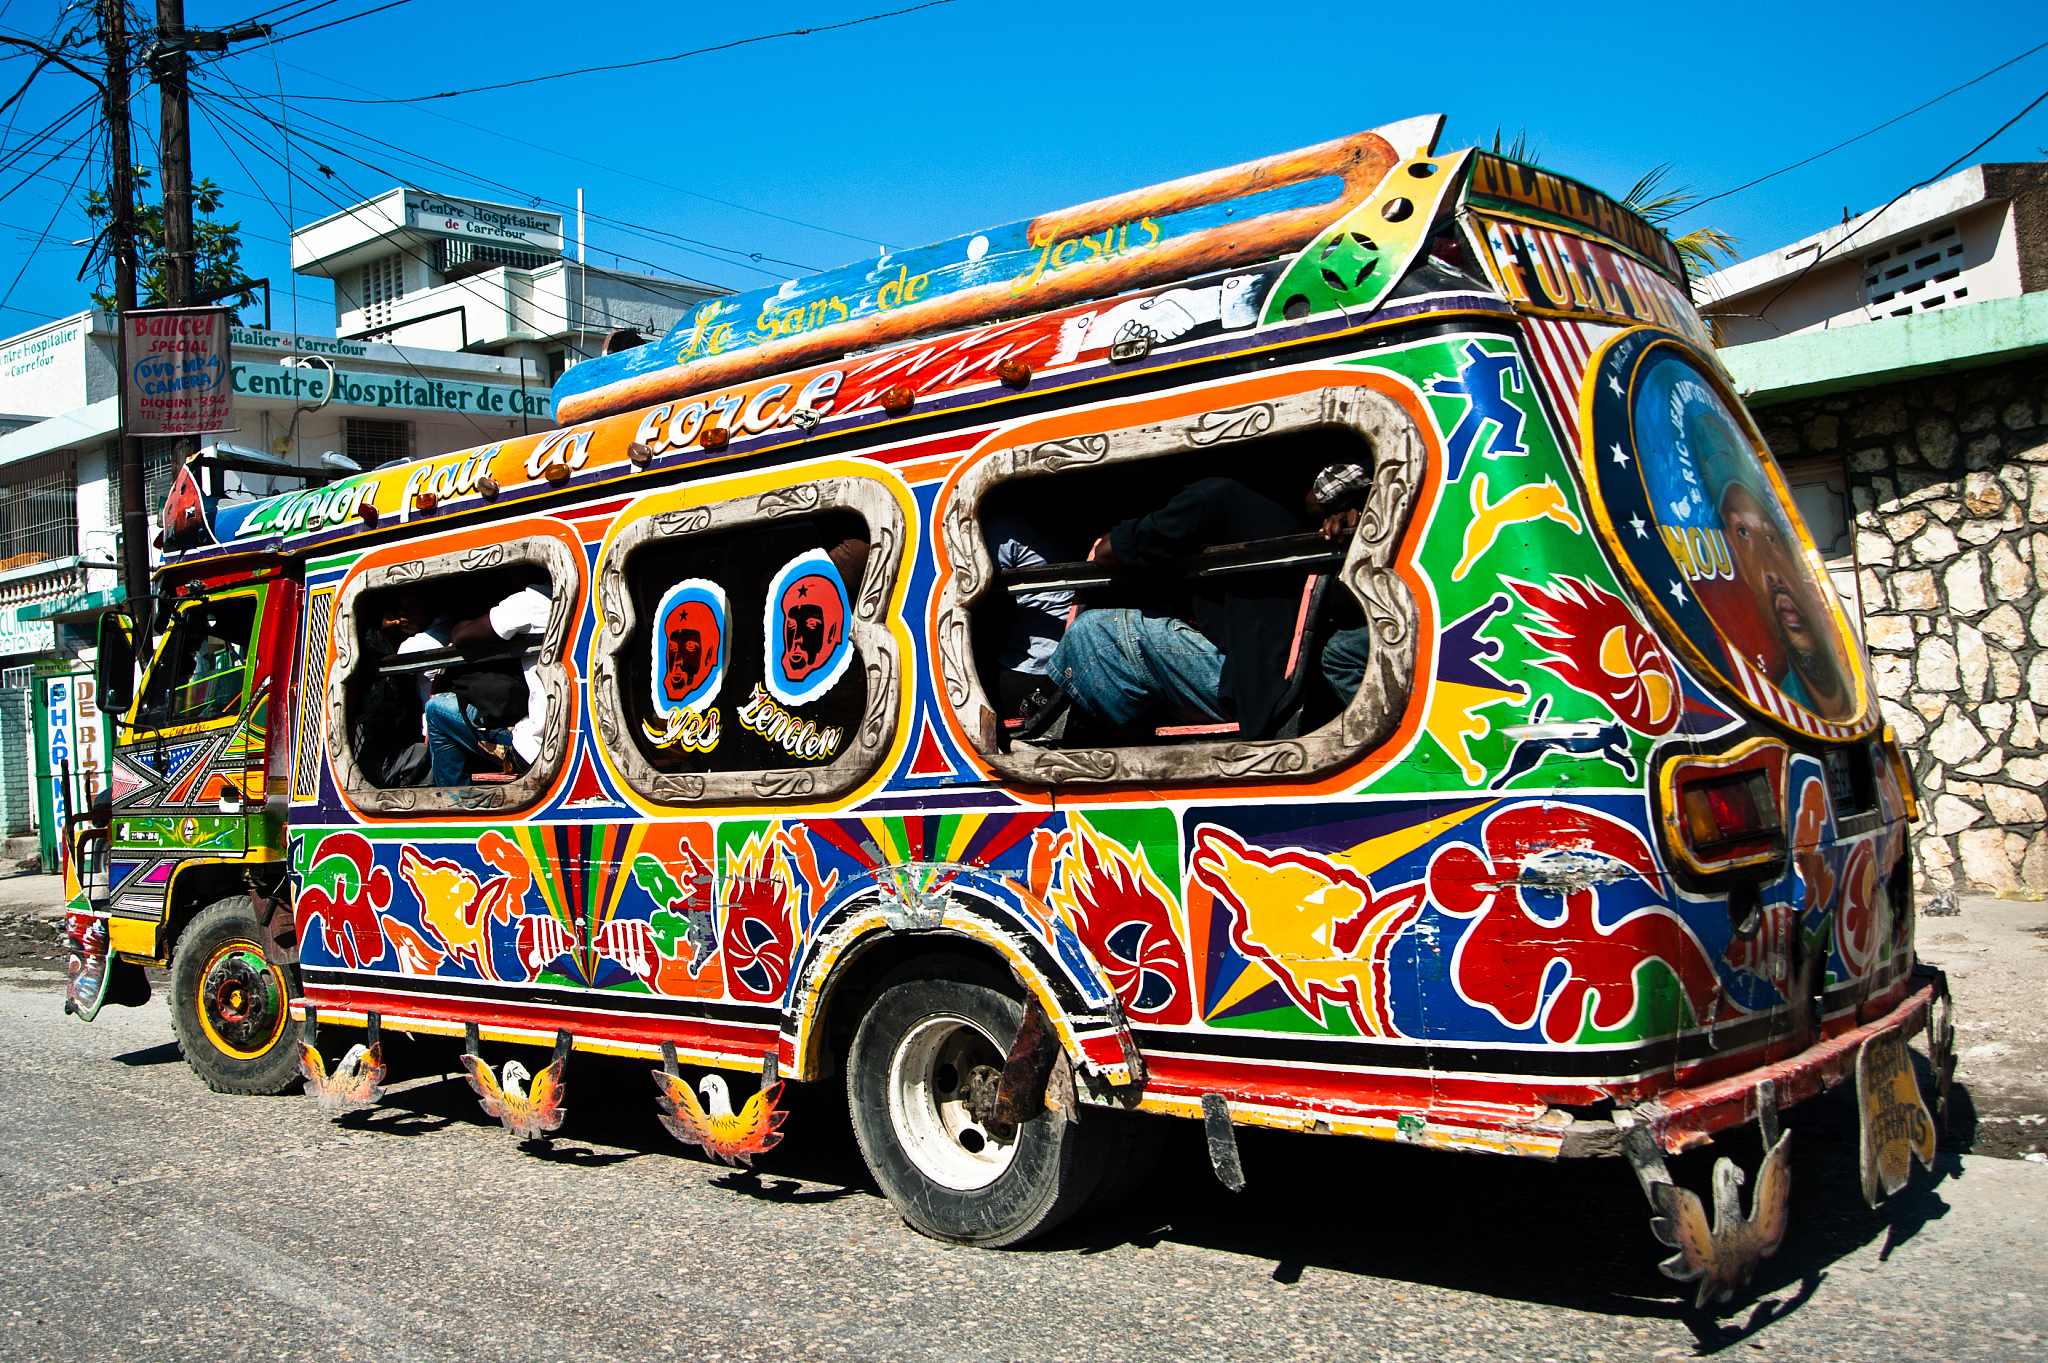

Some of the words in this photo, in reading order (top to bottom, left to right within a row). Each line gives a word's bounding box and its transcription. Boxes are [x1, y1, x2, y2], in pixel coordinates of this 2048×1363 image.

[420, 198, 464, 218] Centre
[472, 205, 550, 232] Hospitalier
[445, 218, 459, 230] de
[466, 221, 526, 240] Carrefour
[1483, 216, 1626, 317] FULL
[676, 299, 731, 364] Le
[877, 264, 929, 311] de
[1009, 214, 1164, 298] Jesus
[0, 348, 22, 365] ntre
[23, 328, 78, 358] Hospitalier
[148, 339, 208, 353] SPECIAL
[229, 328, 281, 347] italier
[282, 337, 293, 347] de
[294, 335, 367, 357] Carrefour
[11, 354, 55, 377] Carrefour
[144, 372, 212, 396] CAMERA
[232, 364, 324, 399] Centre
[332, 374, 473, 411] Hospitalier
[477, 386, 503, 412] de
[140, 397, 192, 409] DIQUINI
[525, 425, 596, 481] la
[632, 369, 846, 474] force
[1675, 440, 1703, 505] ERIC
[641, 705, 721, 753] Yes
